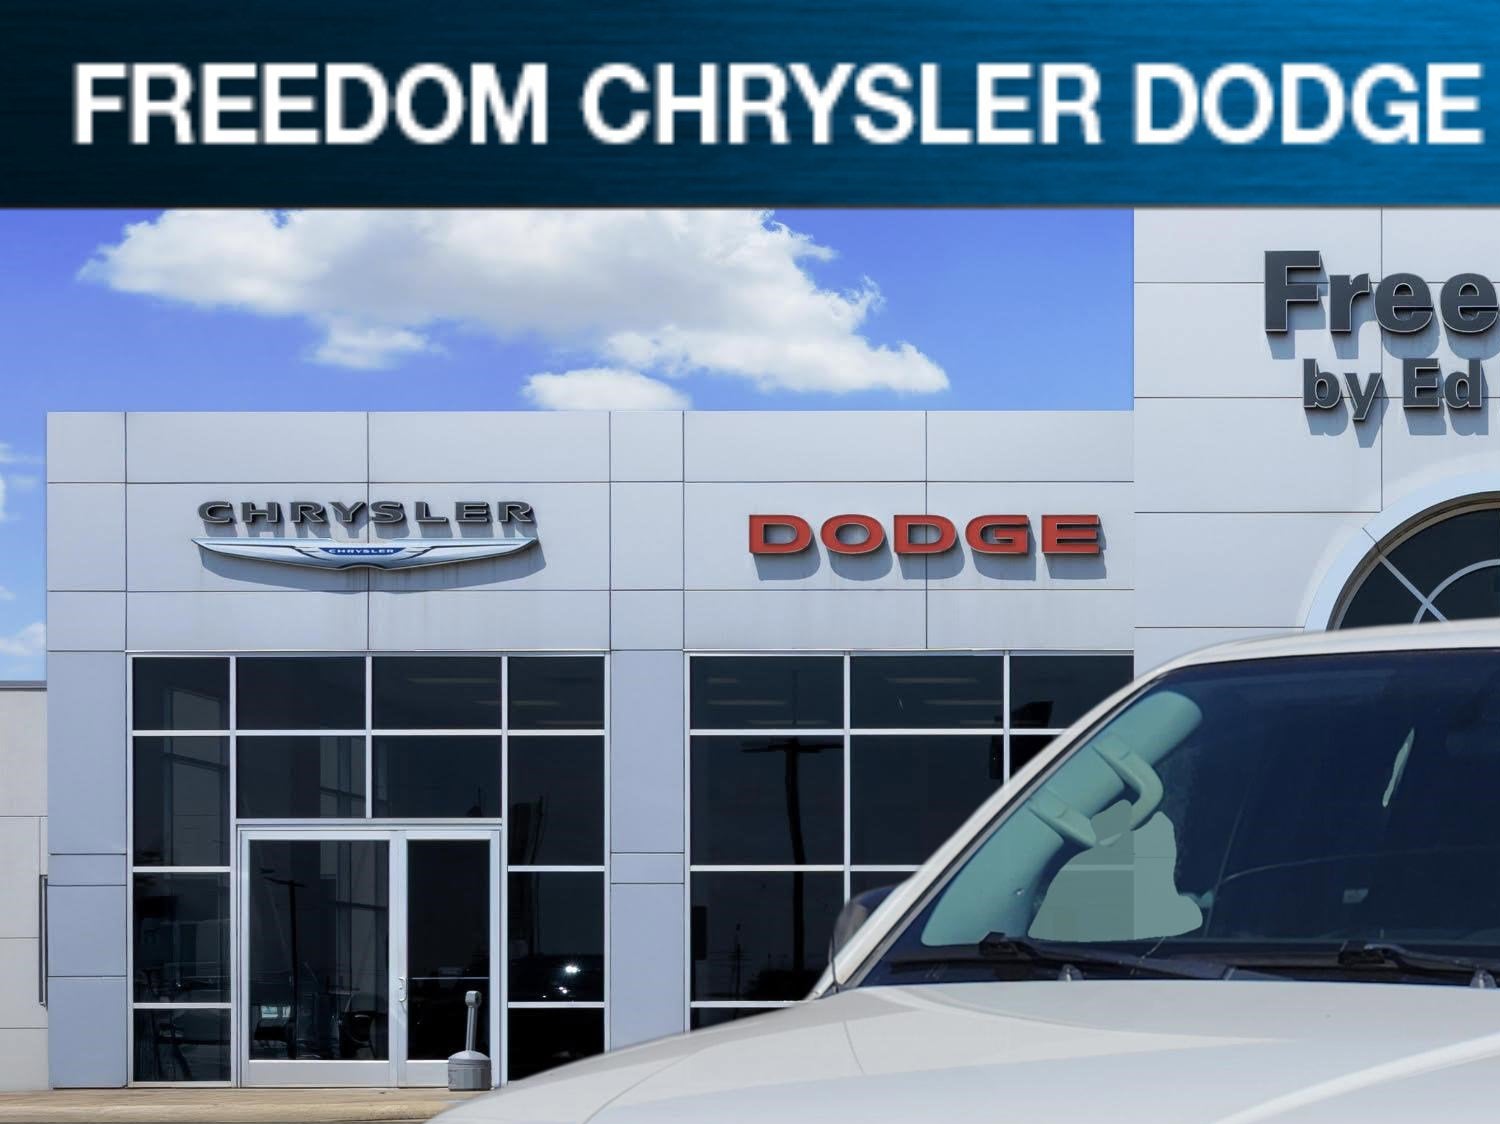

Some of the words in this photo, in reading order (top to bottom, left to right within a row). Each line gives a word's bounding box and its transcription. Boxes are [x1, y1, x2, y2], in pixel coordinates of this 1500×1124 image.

[1303, 358, 1382, 421] by
[1403, 358, 1483, 409] Ed
[198, 500, 538, 524] CHRYSLER
[749, 514, 1101, 554] DODGE
